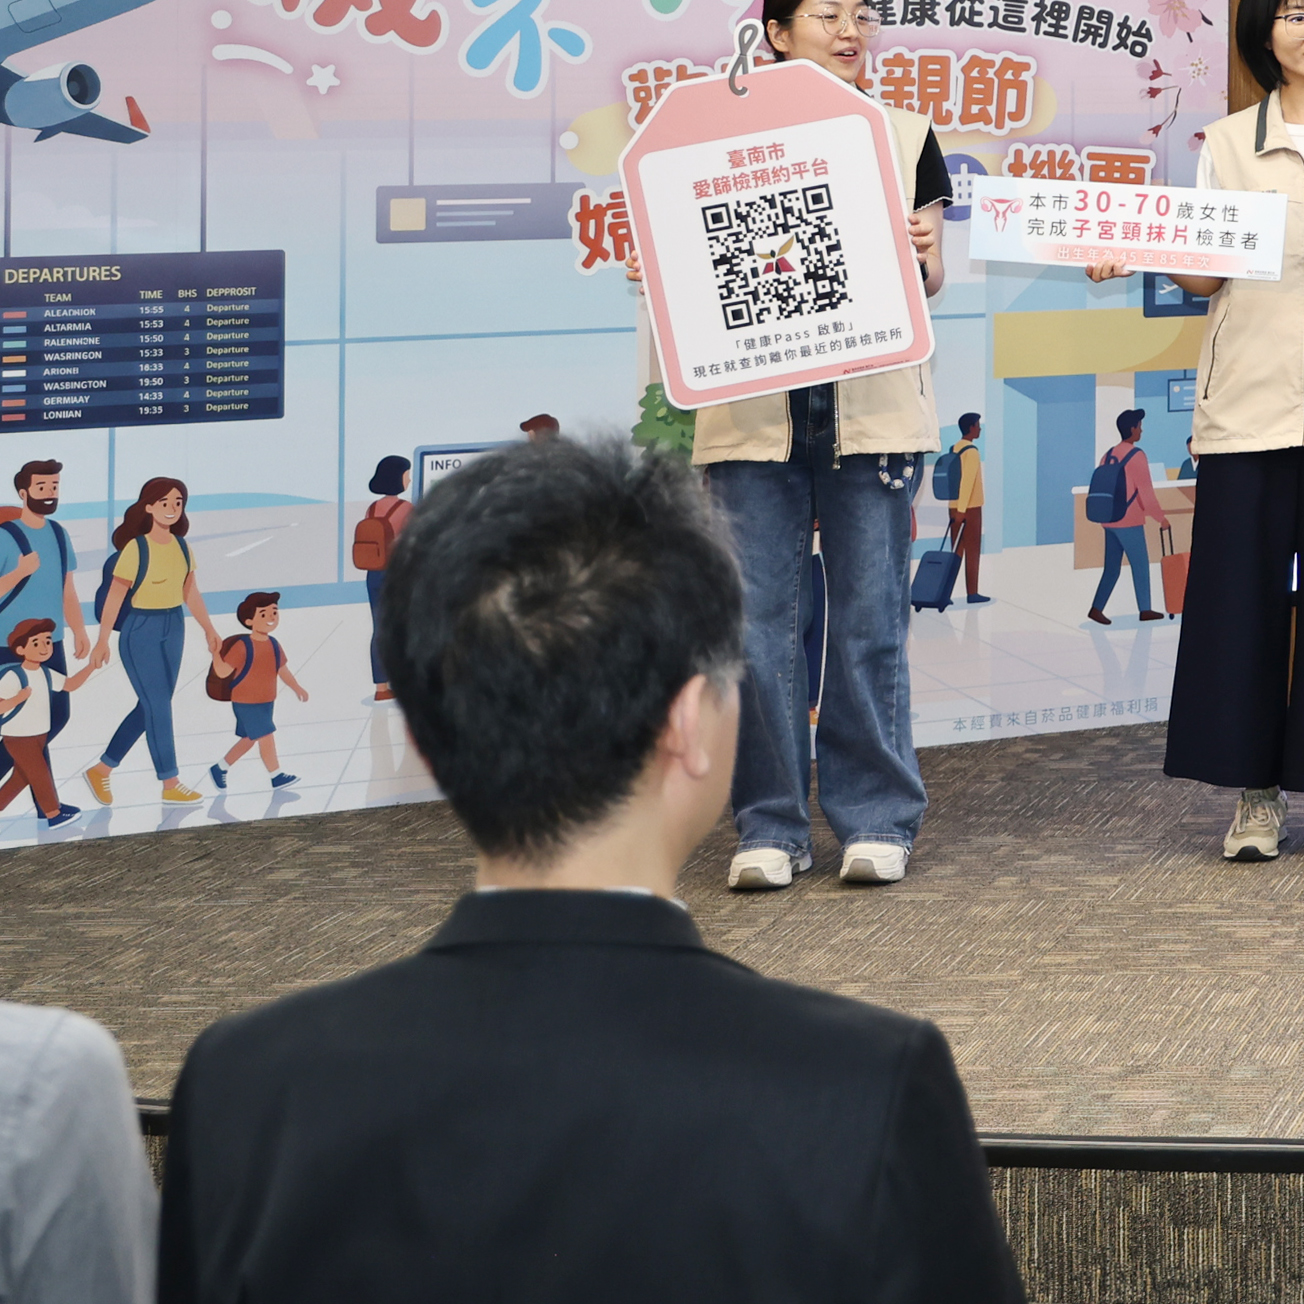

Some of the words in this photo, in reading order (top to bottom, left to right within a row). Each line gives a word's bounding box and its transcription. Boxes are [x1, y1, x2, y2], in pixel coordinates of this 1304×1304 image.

[727, 142, 785, 169] 臺南市
[693, 158, 829, 199] 愛篩檢預約平台
[1029, 189, 1239, 223] 本市30-70歲女性
[1027, 219, 1259, 250] 完成子宮頸抹片檢查者
[5, 266, 121, 284] DEPARTURES
[44, 293, 72, 303] TEAM
[140, 290, 163, 300] TIME
[178, 288, 197, 298] BHS
[207, 287, 256, 297] DEPPROSIT
[139, 305, 164, 314] 15:55
[183, 305, 190, 313] 4
[206, 303, 250, 313] Departure
[139, 320, 164, 329] 15:53
[206, 317, 250, 327] Departure
[139, 334, 164, 343] 15:50
[206, 331, 250, 341] Departure
[139, 349, 164, 357] 15:33
[183, 348, 190, 356] 3
[206, 345, 250, 355] Departure
[693, 327, 903, 378] 現在就查詢離你最近的篩檢院所
[183, 362, 190, 370] 4
[206, 360, 250, 370] Departure
[139, 377, 164, 387] 19:50
[183, 377, 190, 385] 3
[206, 374, 250, 384] Departure
[139, 392, 164, 401] 14:33
[183, 391, 190, 399] 4
[206, 388, 250, 398] Departure
[139, 406, 164, 415] 19:35
[183, 405, 190, 413] 3
[206, 402, 250, 412] Departure
[431, 459, 462, 471] INFO
[953, 697, 1158, 732] 本經費來自菸品健康福利捐
